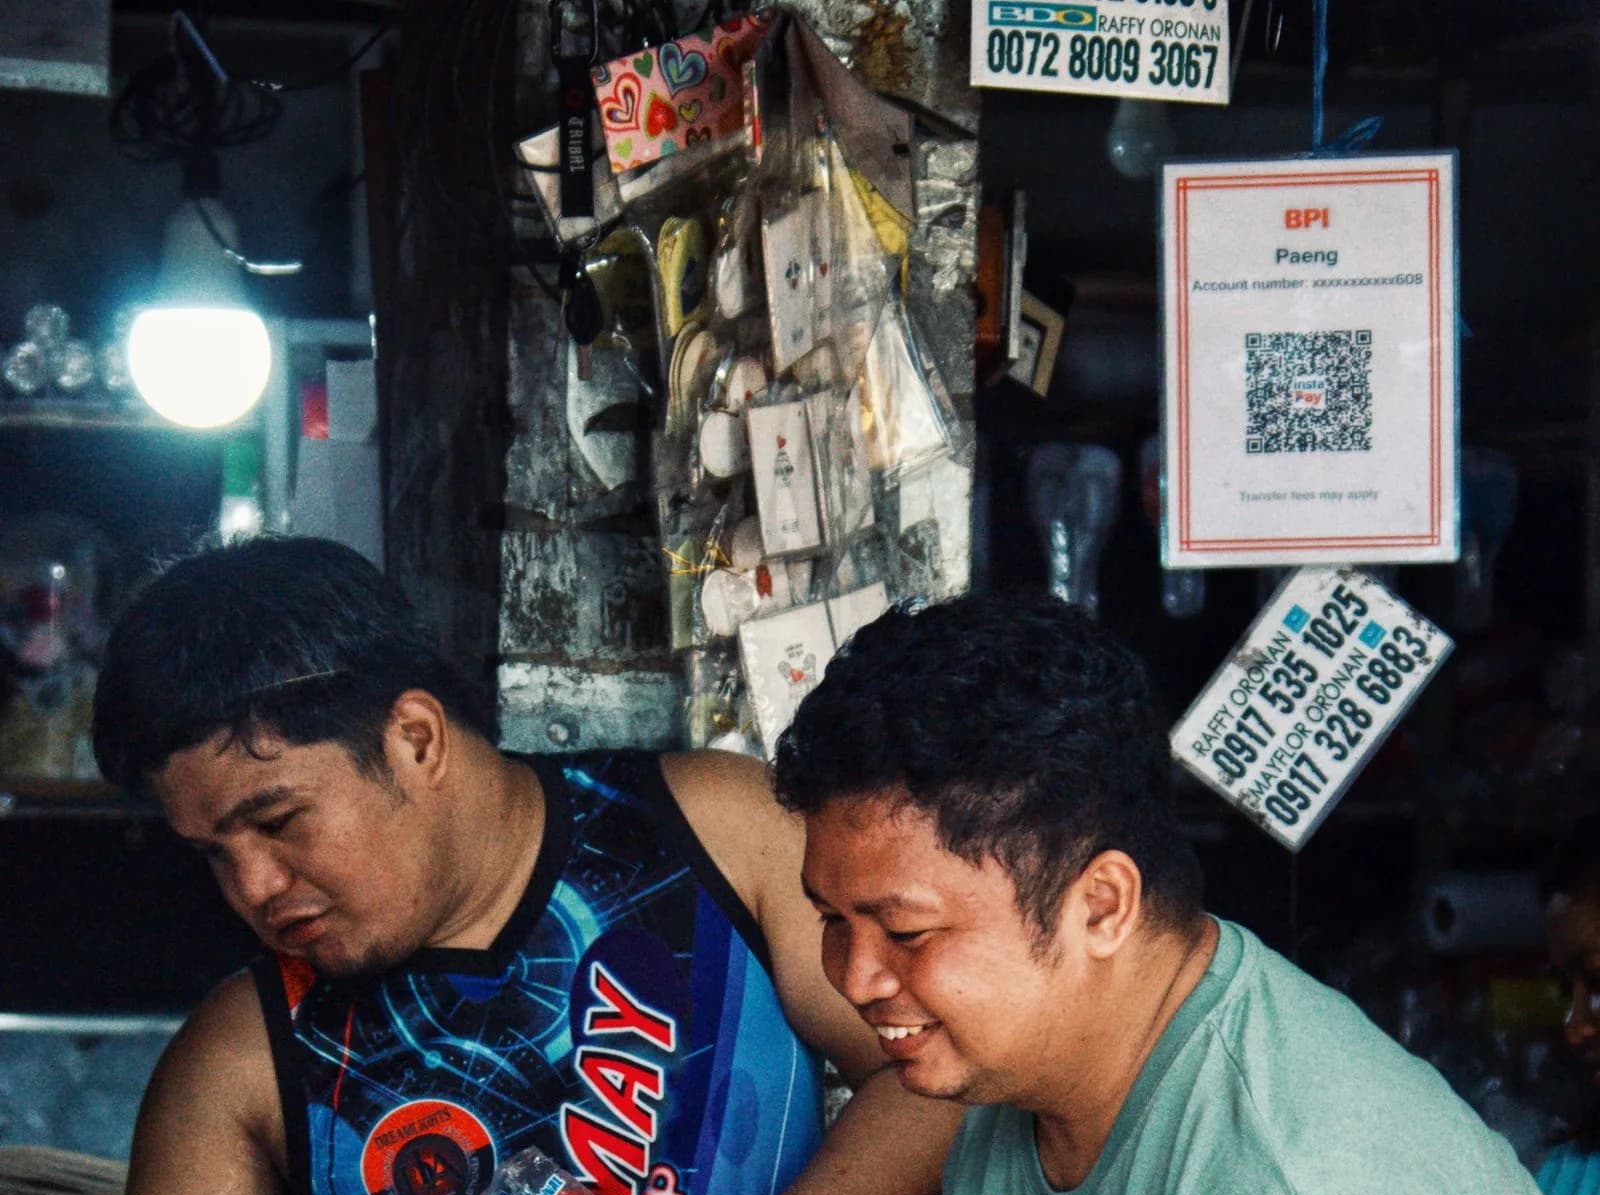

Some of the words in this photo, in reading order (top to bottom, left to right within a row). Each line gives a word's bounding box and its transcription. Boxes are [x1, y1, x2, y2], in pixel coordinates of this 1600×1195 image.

[991, 6, 1093, 26] BDO
[1098, 14, 1146, 35] RAFFY
[1150, 18, 1221, 41] ORONAN
[987, 29, 1060, 77] 0072
[1068, 34, 1141, 83] 8009
[1148, 40, 1219, 89] 3067
[1284, 208, 1330, 229] BPI
[1192, 279, 1248, 291] Account
[1252, 278, 1307, 291] number:
[1275, 248, 1338, 266] Paeng
[1191, 704, 1236, 757] RAFFY
[1230, 630, 1291, 707] ORONAN
[1212, 707, 1276, 779] 0917
[1258, 651, 1318, 715] 535
[1302, 583, 1369, 659] 1025
[1248, 722, 1312, 804] MAYFLOR
[1306, 646, 1368, 723] ORONAN
[1264, 752, 1329, 827] 0917
[1314, 697, 1373, 762] 328
[1356, 625, 1428, 705] 6883
